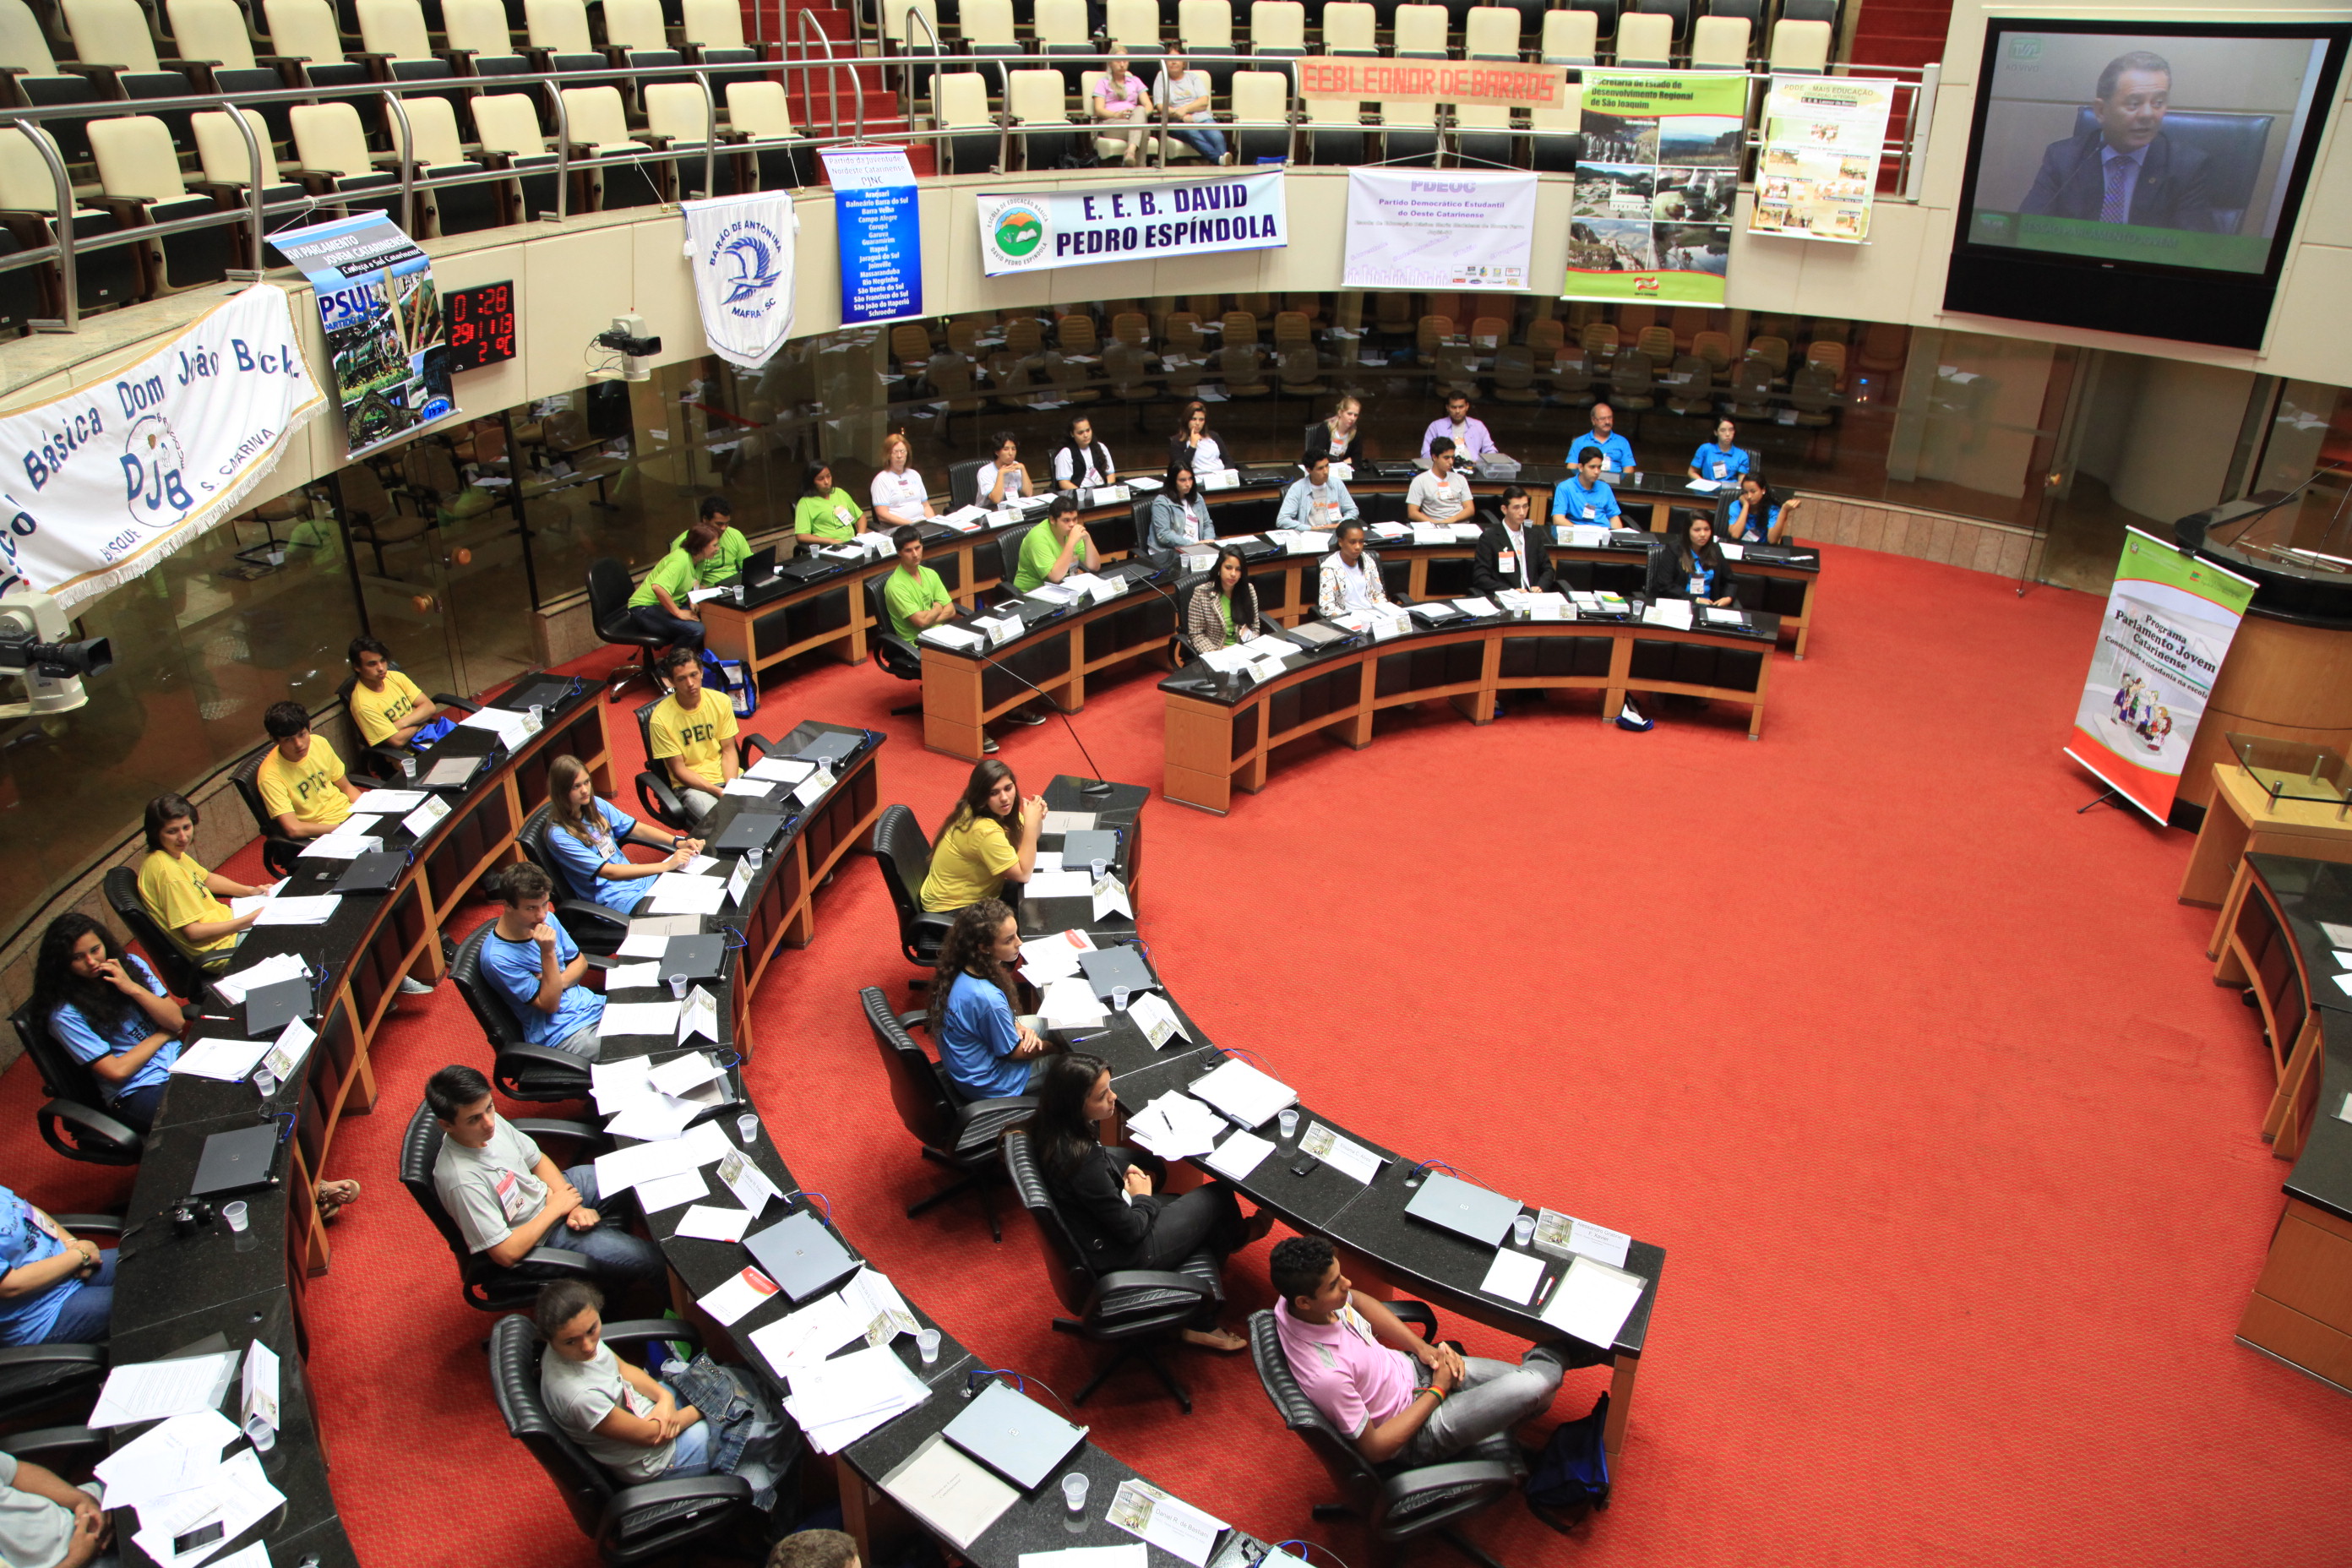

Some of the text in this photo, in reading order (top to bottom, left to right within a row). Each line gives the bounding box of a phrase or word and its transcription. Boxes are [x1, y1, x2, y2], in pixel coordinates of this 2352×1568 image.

[1302, 63, 1555, 101] EEB LEONOR DE BARROS
[1591, 88, 1694, 101] Desenvolvimento Regional
[1832, 86, 1874, 97] EDUCAÇÃO
[1591, 98, 1649, 110] de São Joaquim
[829, 156, 854, 165] Partido
[831, 165, 906, 175] Nordeste Catarinense
[1411, 179, 1477, 193] PDEOC
[865, 190, 890, 199] Araquari
[846, 199, 874, 208] Balneário
[900, 196, 909, 204] Sul
[1082, 183, 1249, 221] E. E. B. DAVID
[1379, 198, 1505, 209] Partido Democrático Estudantil
[879, 205, 895, 214] Velha
[987, 208, 1000, 228] ESCOLA
[1007, 197, 1034, 207] EDUCAÇÃO
[1034, 204, 1048, 222] BÁSICA
[1410, 210, 1435, 218] Oeste
[1436, 210, 1484, 219] Catarinense
[858, 215, 898, 224] Campo Alegre
[868, 223, 889, 231] Corupá
[862, 237, 896, 246] Guaramirim
[1056, 214, 1277, 257] PEDRO ESPÍNDOLA
[283, 234, 359, 262] XVI PARLAMENTO
[710, 220, 781, 266] BARÃO DE ANTONINA
[323, 234, 411, 266] JOVEM CATARINENSE
[869, 245, 889, 254] Itapoá
[990, 242, 1048, 266] DAVID PEDRO ESPÍNDOLA
[859, 253, 881, 264] Jaraguá
[868, 260, 892, 270] Joinville
[860, 268, 901, 278] Massaranduba
[863, 276, 899, 286] Rio Negrinho
[869, 285, 886, 293] Bento
[895, 282, 905, 291] Sul
[865, 293, 890, 302] Francisco
[900, 290, 909, 298] Sul
[318, 283, 379, 322] PSUL
[732, 306, 761, 318] MAFRA
[765, 297, 776, 310] SC
[865, 302, 879, 311] João
[887, 297, 910, 308] Itaperiú
[868, 308, 896, 317] Schroeder
[23, 407, 104, 493] Básica
[116, 374, 166, 421] Dom
[177, 345, 219, 386] João
[119, 452, 195, 511] DJB
[2146, 614, 2187, 645] Programa
[2115, 609, 2217, 674] Parlamento Jovem
[2133, 633, 2187, 672] Catarinense
[2105, 635, 2142, 661] Construindo
[2145, 661, 2177, 682] cidadania
[2177, 679, 2186, 688] na
[2186, 684, 2208, 700] escola
[681, 723, 714, 747] PEC
